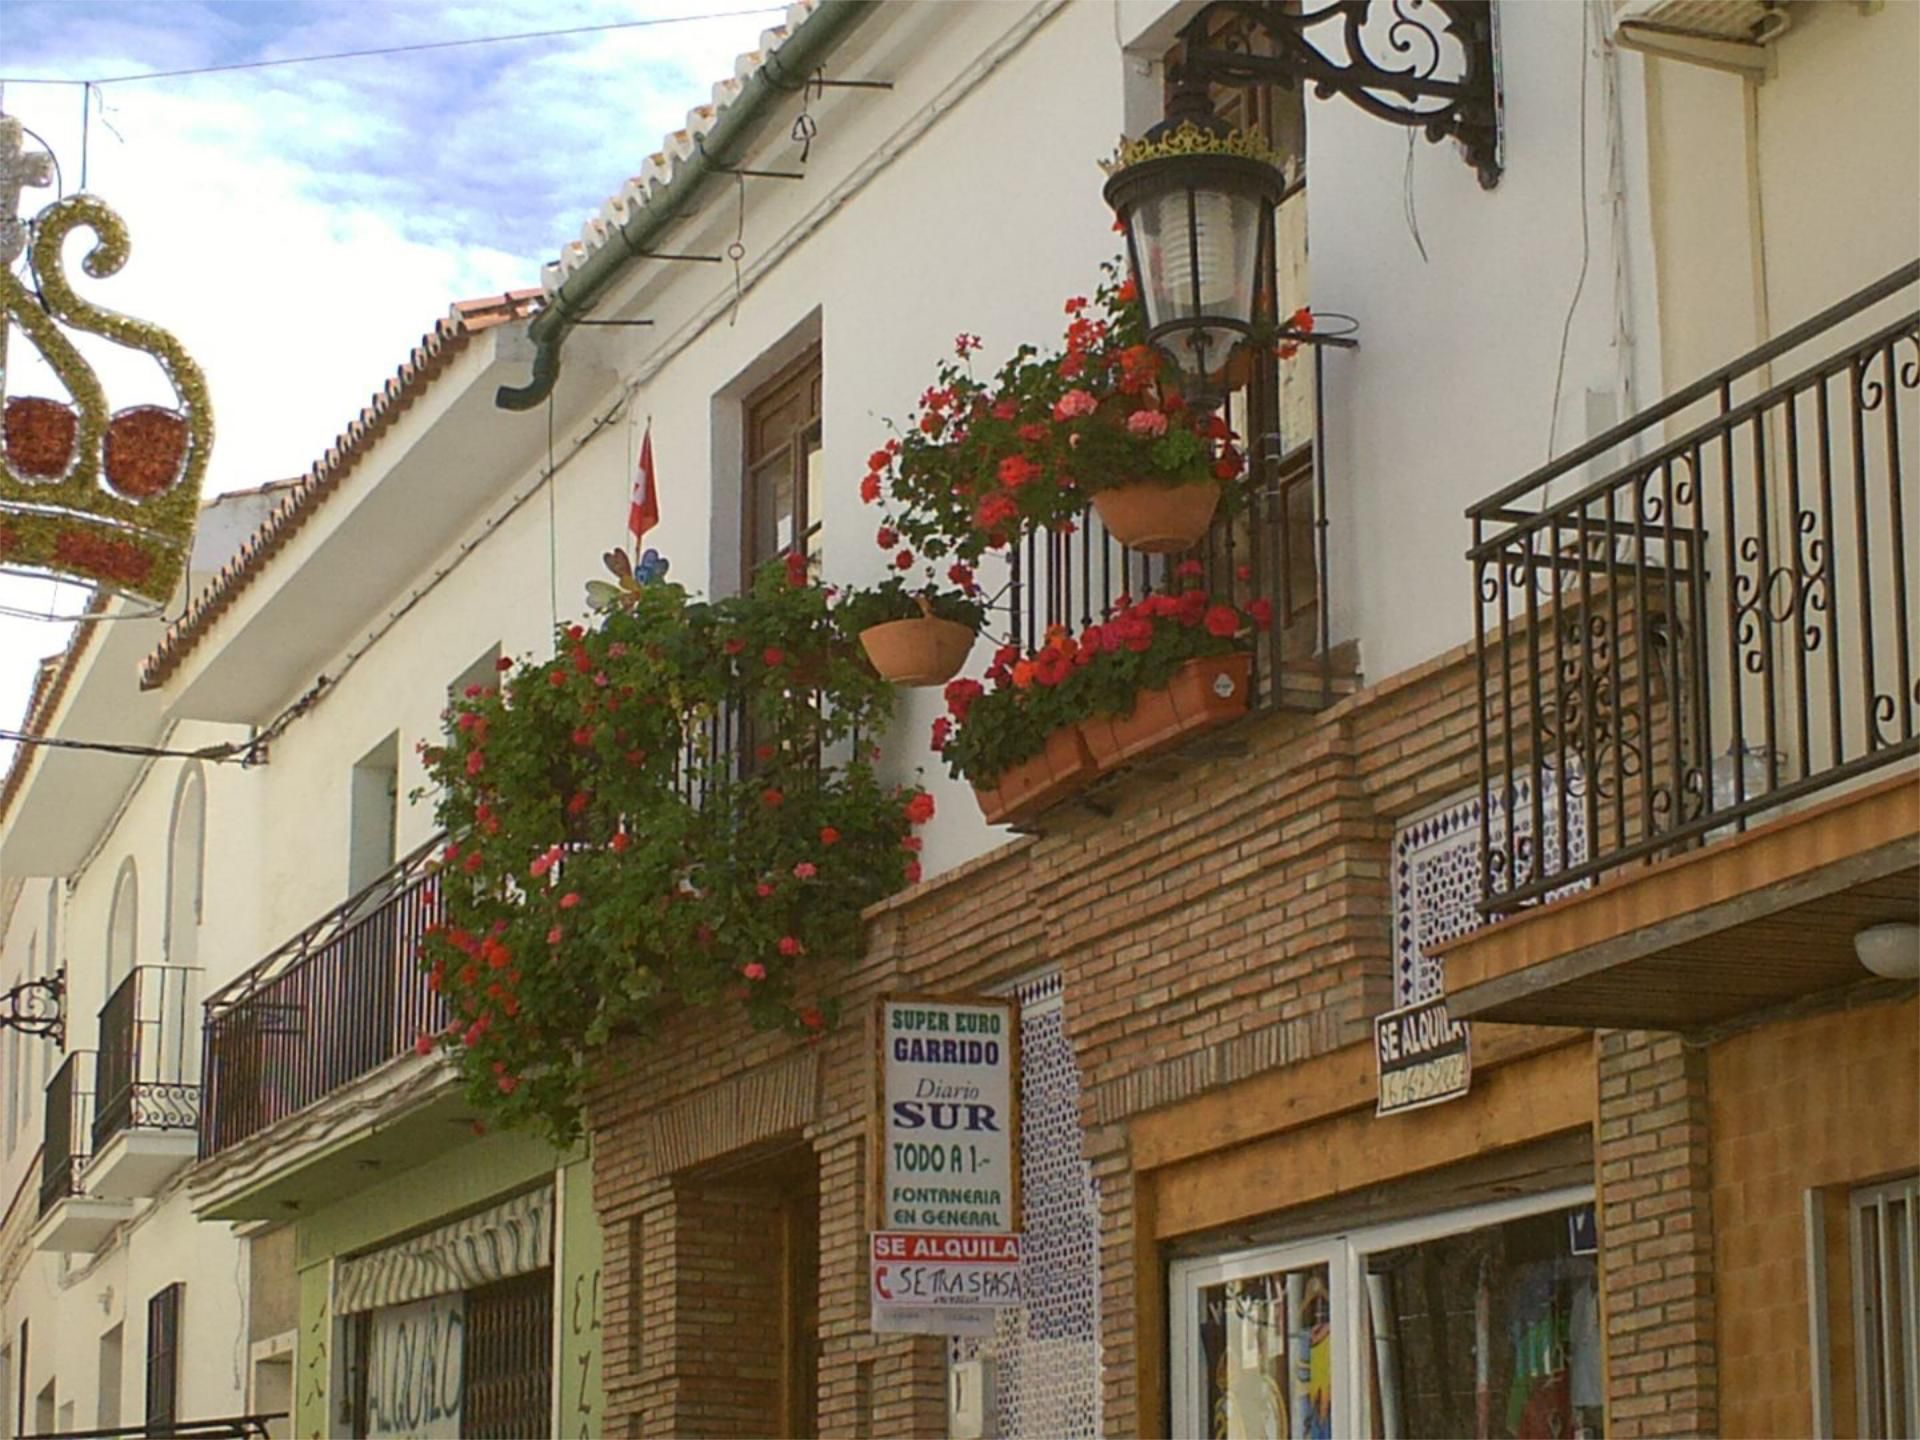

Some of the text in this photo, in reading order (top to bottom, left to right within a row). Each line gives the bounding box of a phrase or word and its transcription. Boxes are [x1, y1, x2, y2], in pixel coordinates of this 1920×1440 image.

[892, 1009, 1001, 1034] SUPER EURO
[893, 1037, 999, 1066] GARRIDO
[1380, 1021, 1400, 1063] SE
[915, 1077, 980, 1100] Diario
[892, 1101, 1001, 1132] SUR
[893, 1143, 945, 1172] TODO
[950, 1145, 962, 1173] A
[892, 1187, 1001, 1205] FONTANERIA
[893, 1208, 1001, 1227] EN GENERAL
[875, 1237, 1018, 1258] SE ALQUILA
[897, 1266, 927, 1296] SE
